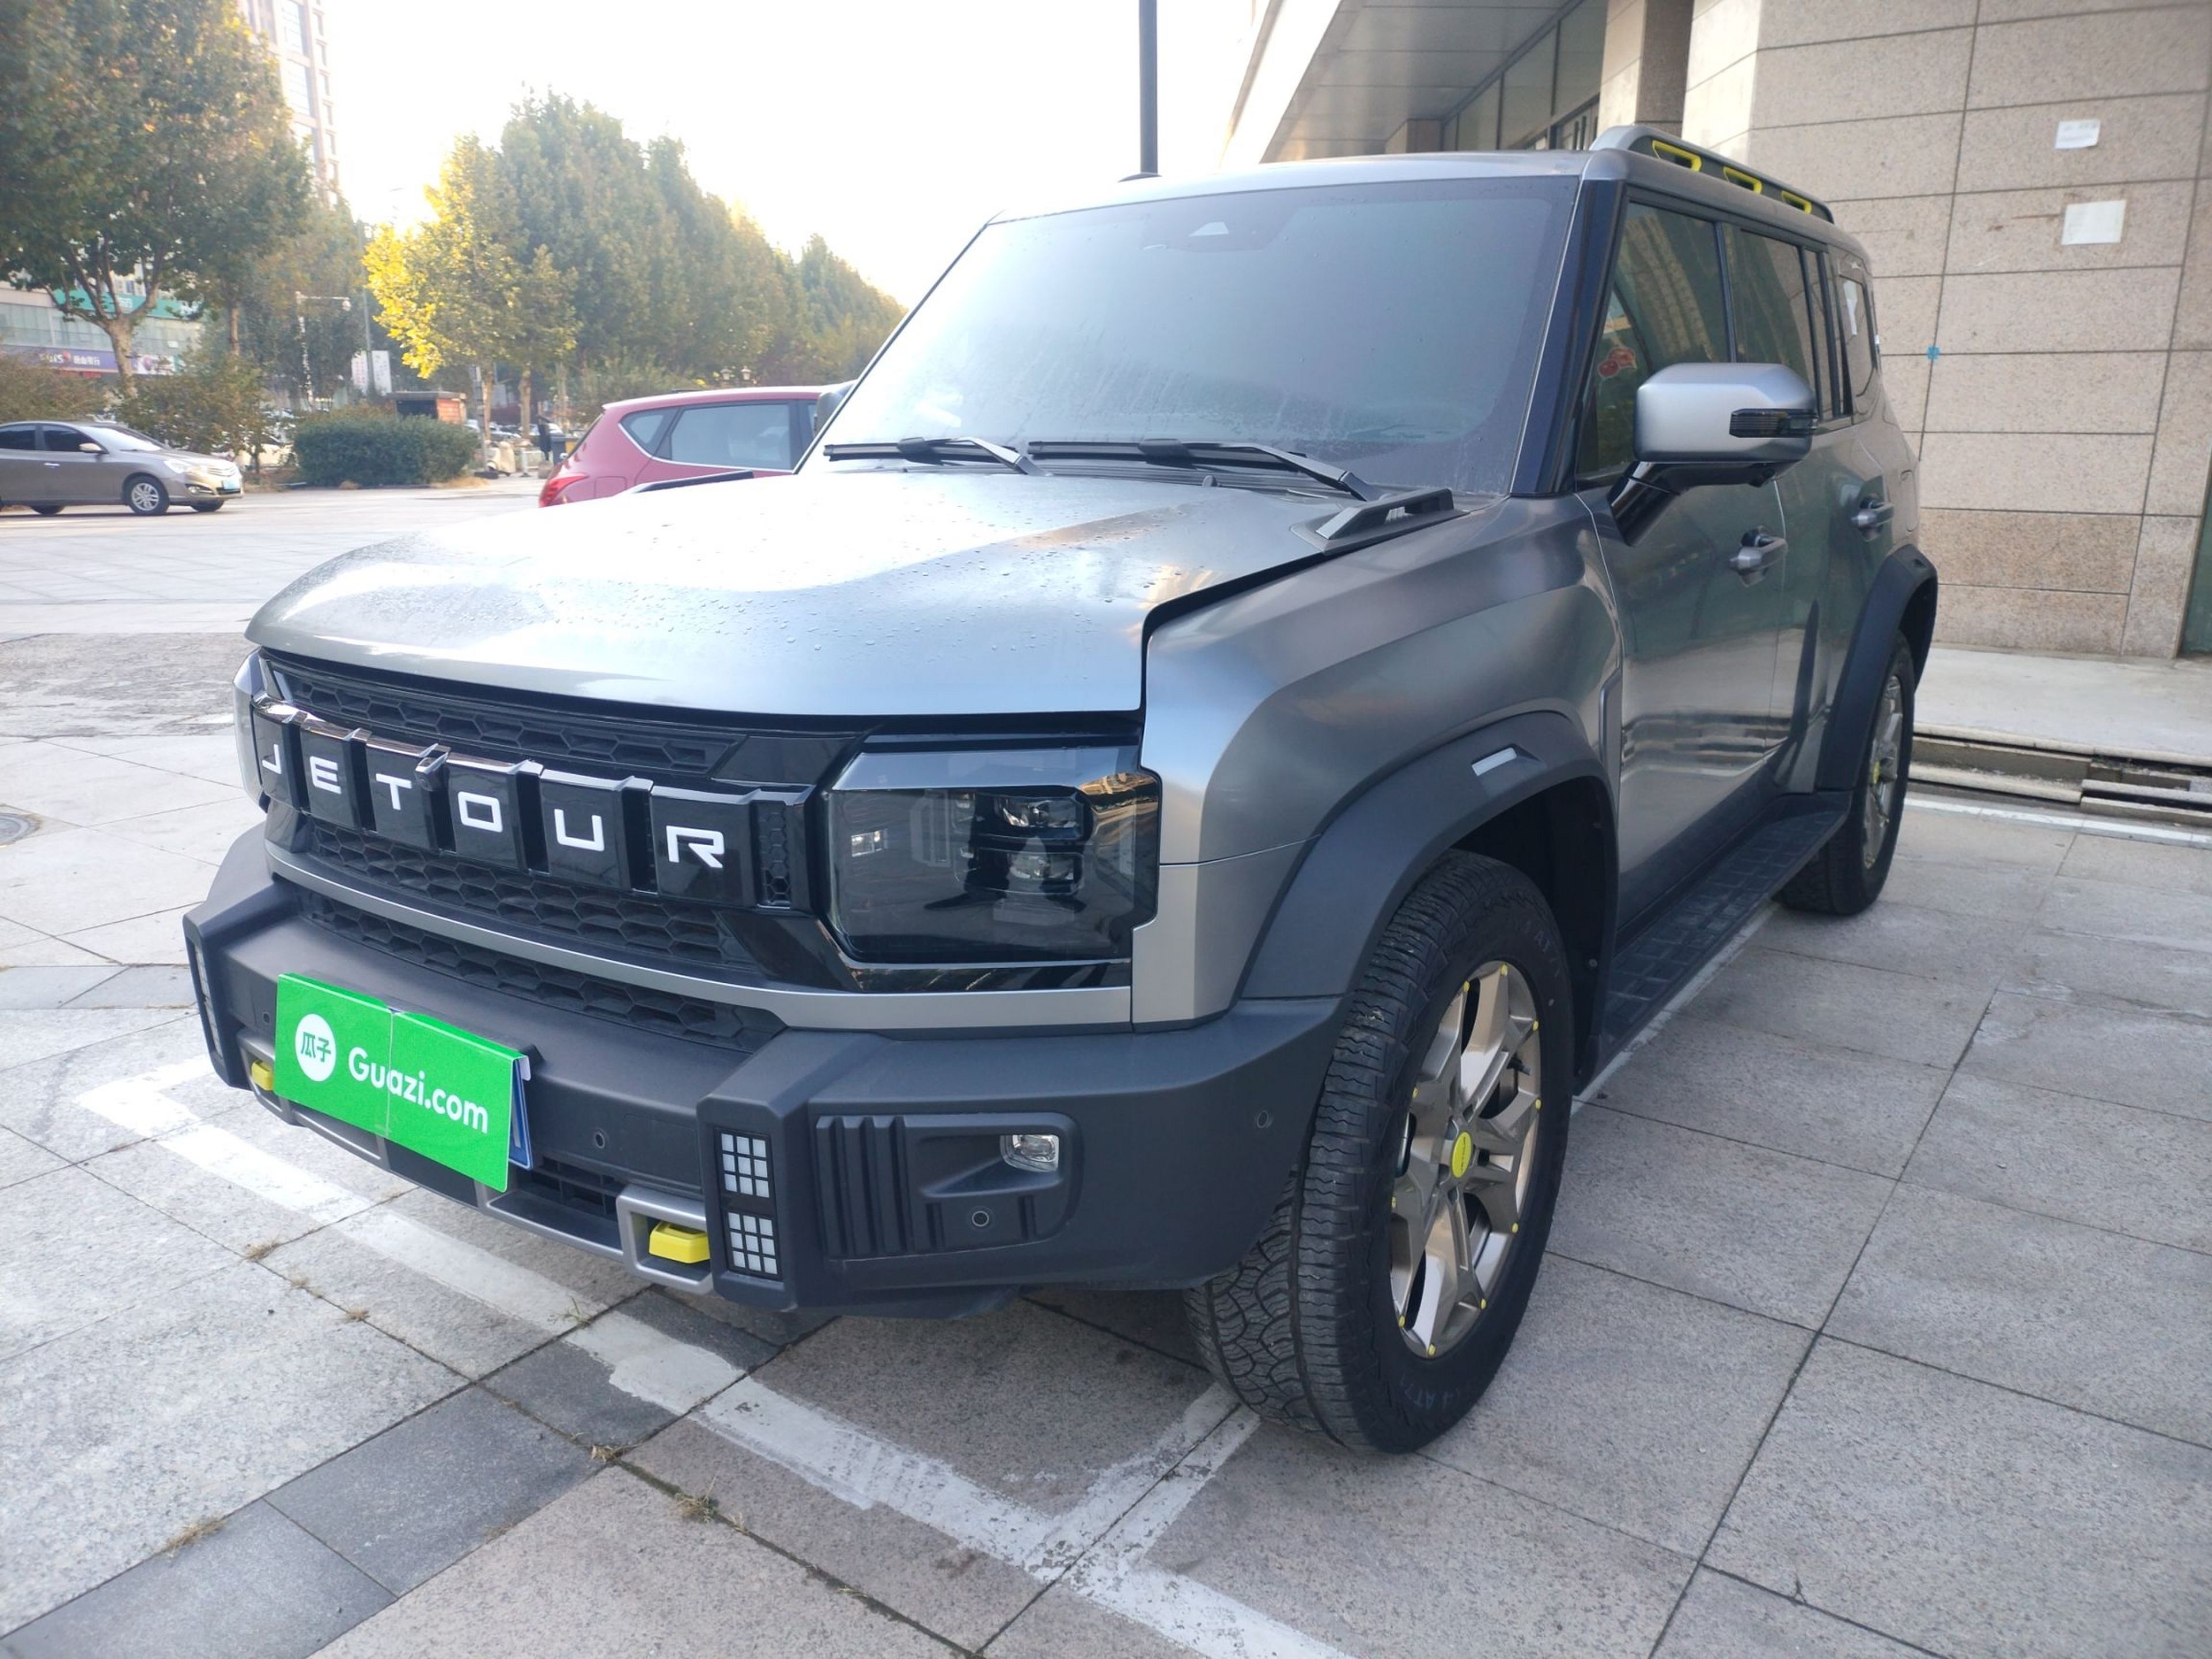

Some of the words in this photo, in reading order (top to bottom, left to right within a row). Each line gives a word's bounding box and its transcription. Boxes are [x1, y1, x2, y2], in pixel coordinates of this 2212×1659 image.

[262, 744, 725, 868] JETOUR
[300, 1032, 332, 1062] 瓜子
[348, 1046, 488, 1134] Guazi.com
